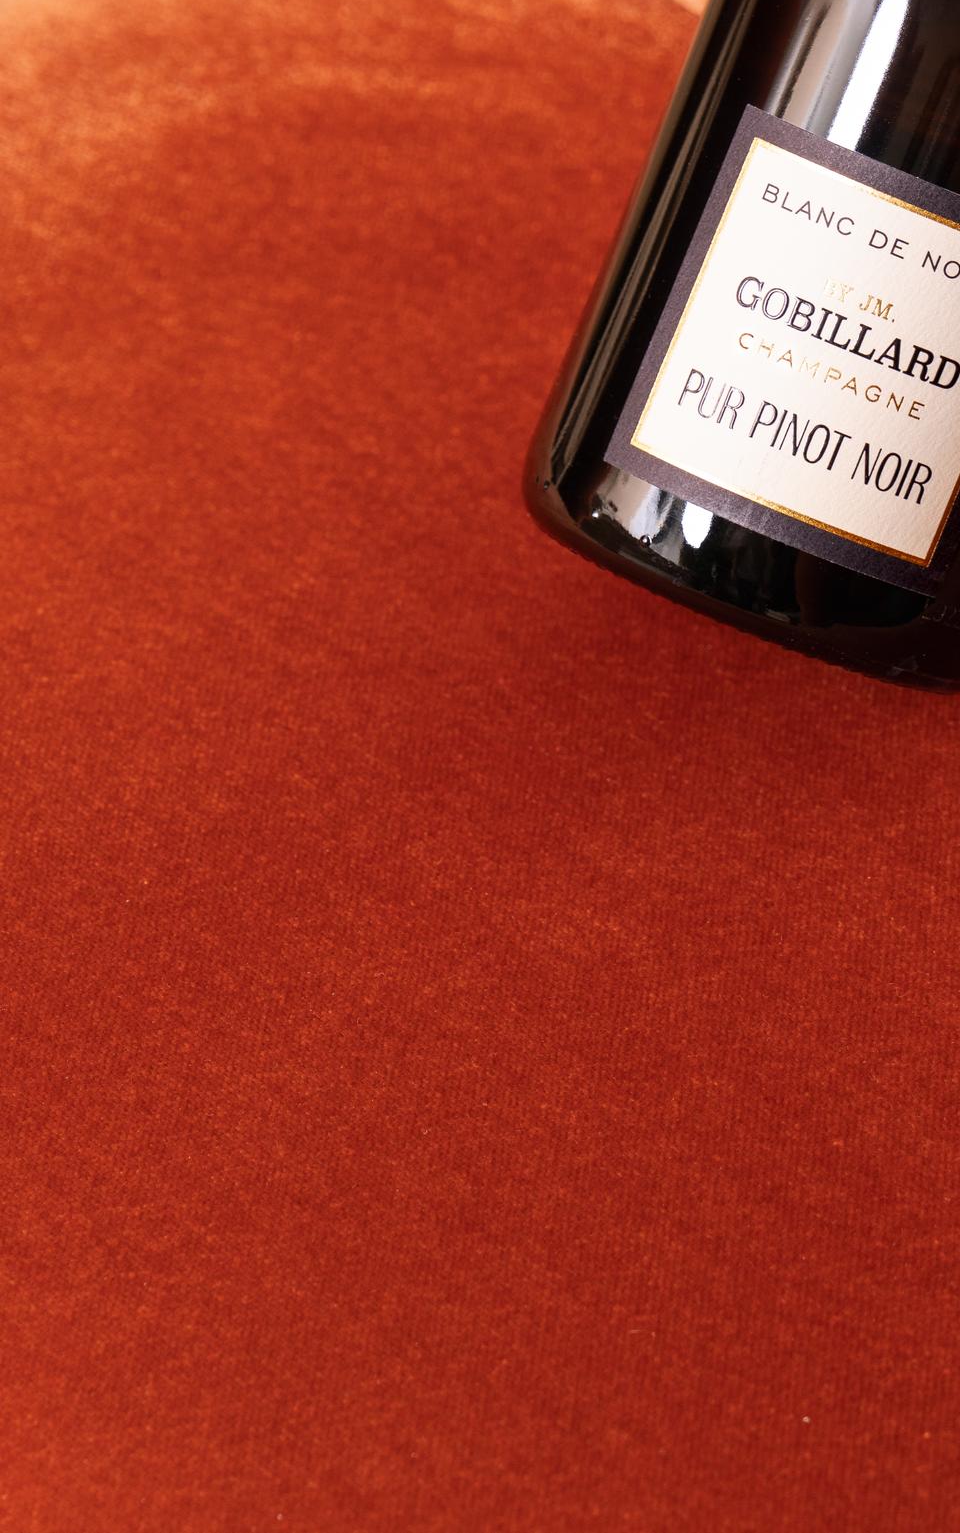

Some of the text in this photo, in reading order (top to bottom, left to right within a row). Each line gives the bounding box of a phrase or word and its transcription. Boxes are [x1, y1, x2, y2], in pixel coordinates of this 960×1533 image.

[761, 183, 855, 236] BLANC
[868, 229, 909, 260] DE
[824, 276, 895, 323] BY JM.
[738, 332, 925, 420] CHAMPAGNE
[677, 368, 933, 505] PUR PINOT NOIR
